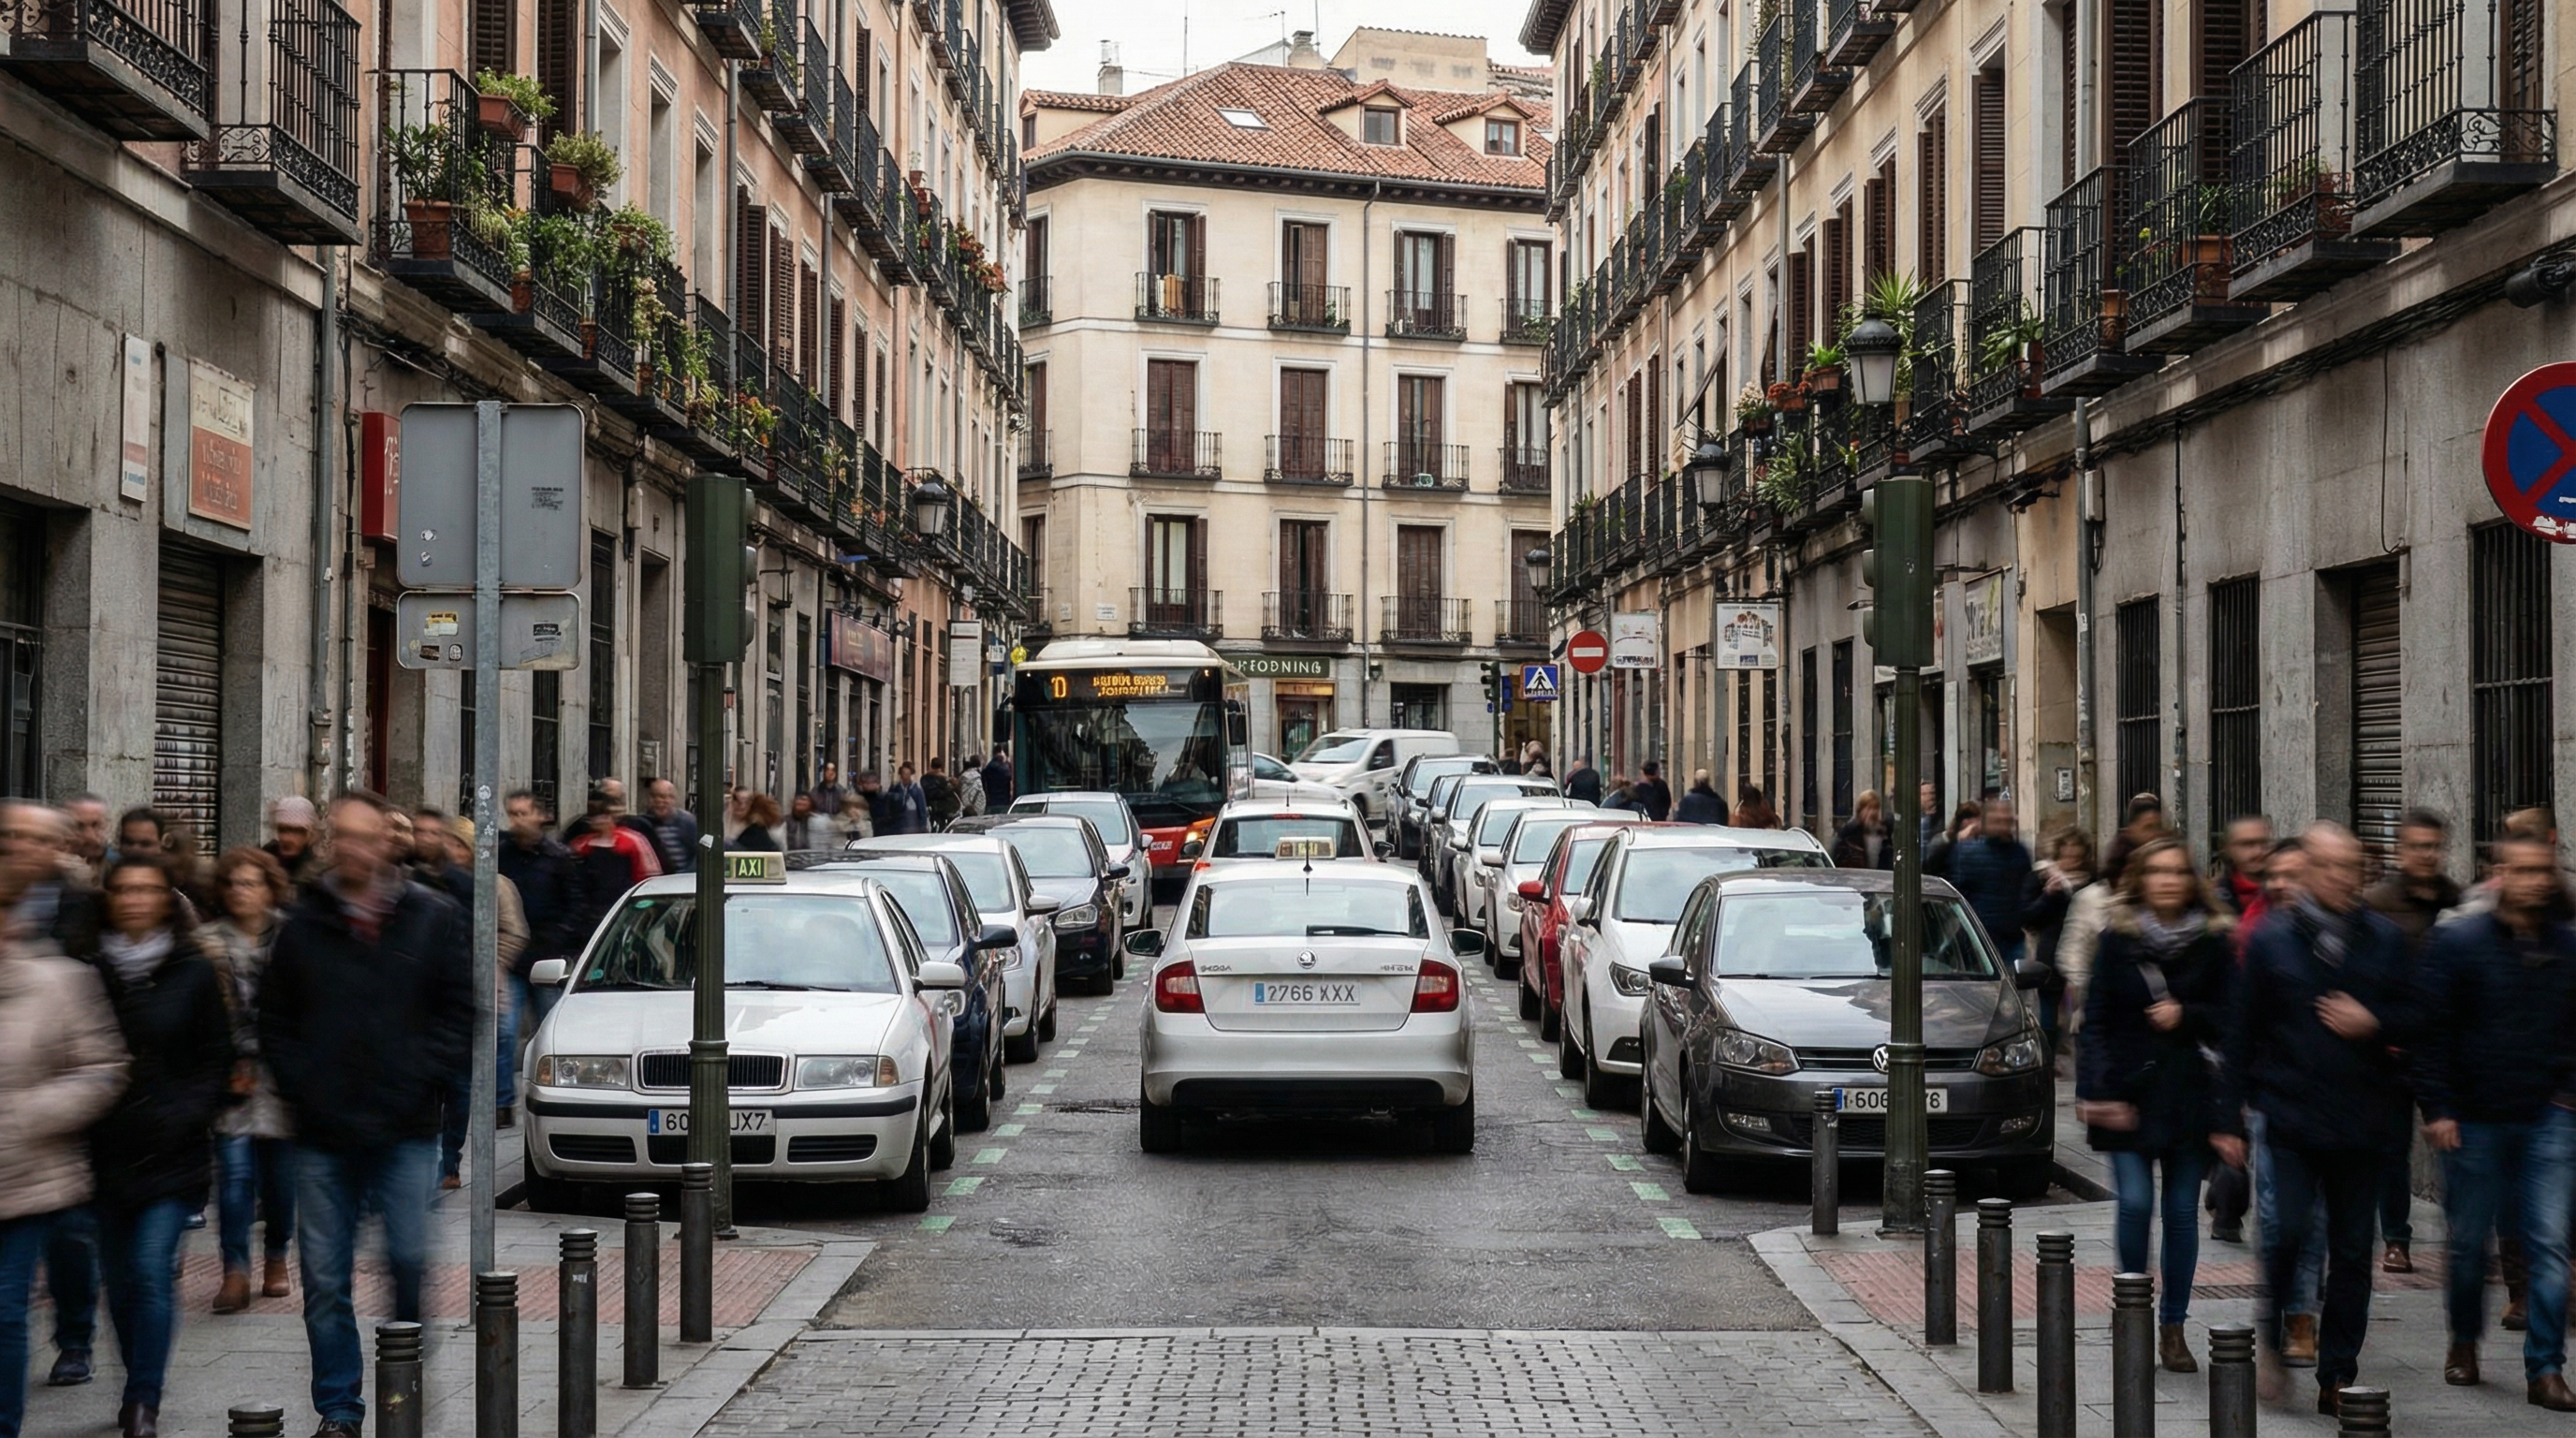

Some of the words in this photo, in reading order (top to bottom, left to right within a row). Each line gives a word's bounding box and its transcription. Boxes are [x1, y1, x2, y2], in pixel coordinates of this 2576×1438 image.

[738, 858, 762, 876] AXI
[1267, 985, 1313, 1002] 2766
[1320, 985, 1355, 1002] KXX
